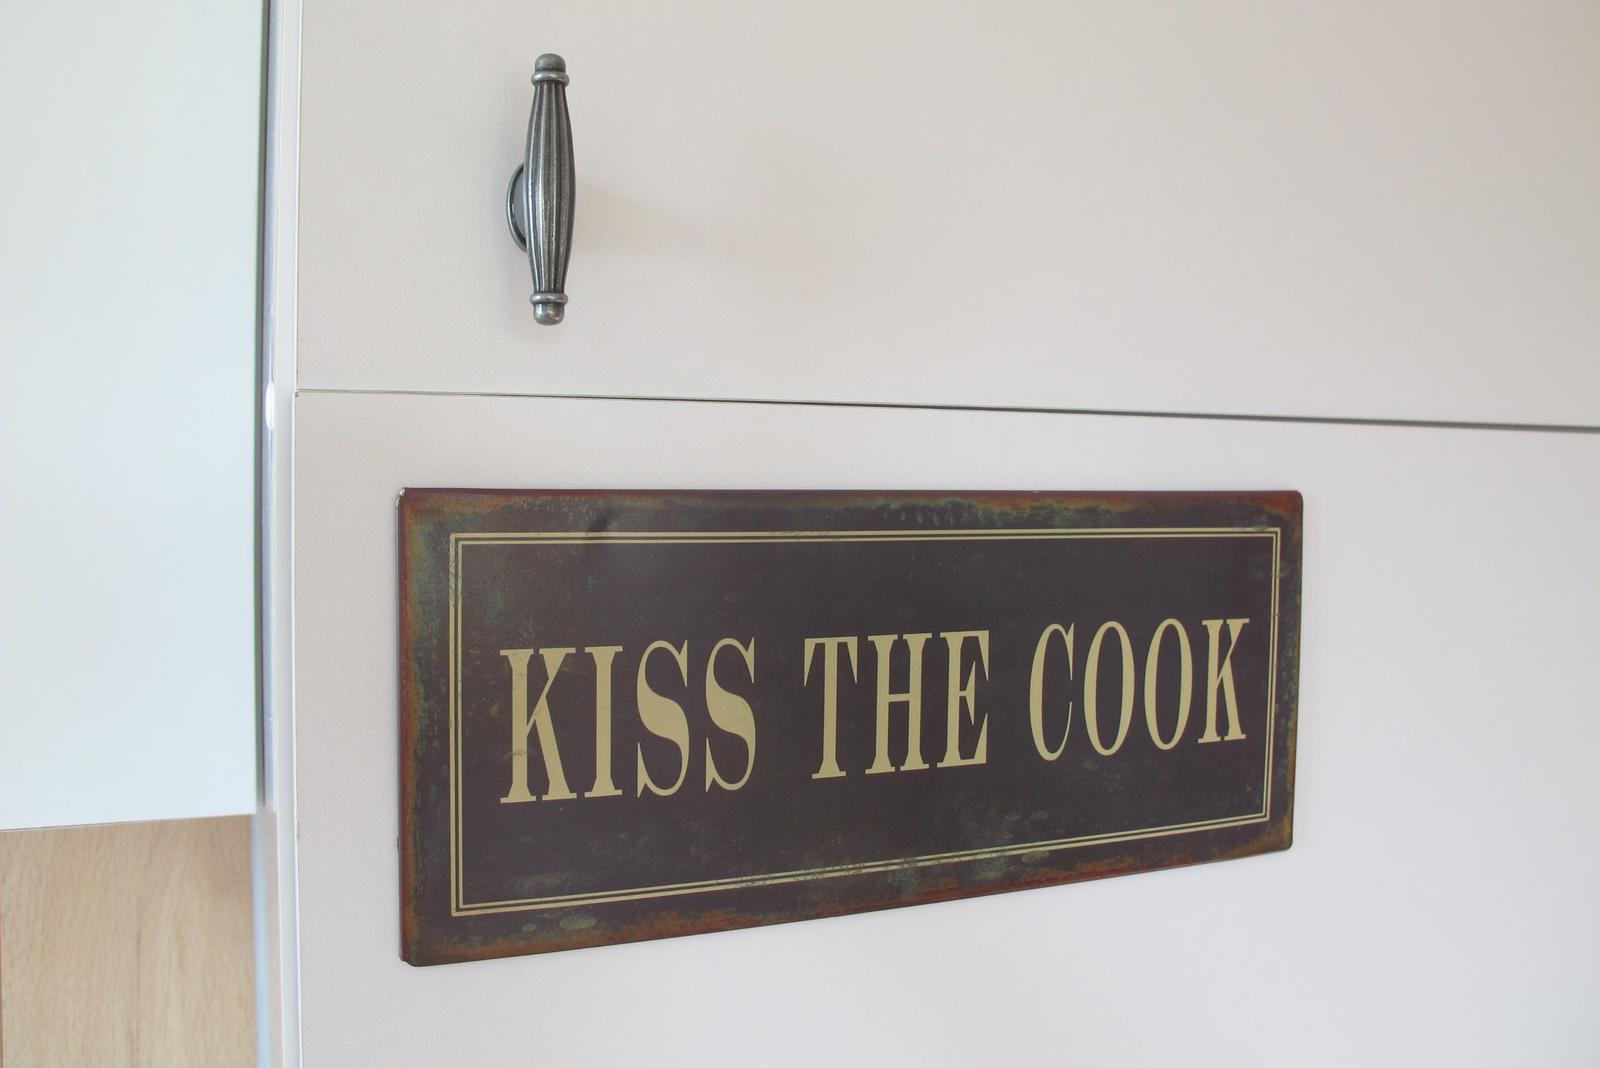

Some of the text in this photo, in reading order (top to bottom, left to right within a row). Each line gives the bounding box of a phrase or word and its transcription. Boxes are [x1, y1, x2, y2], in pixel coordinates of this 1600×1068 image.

[499, 618, 1250, 804] KISS THE COOK
